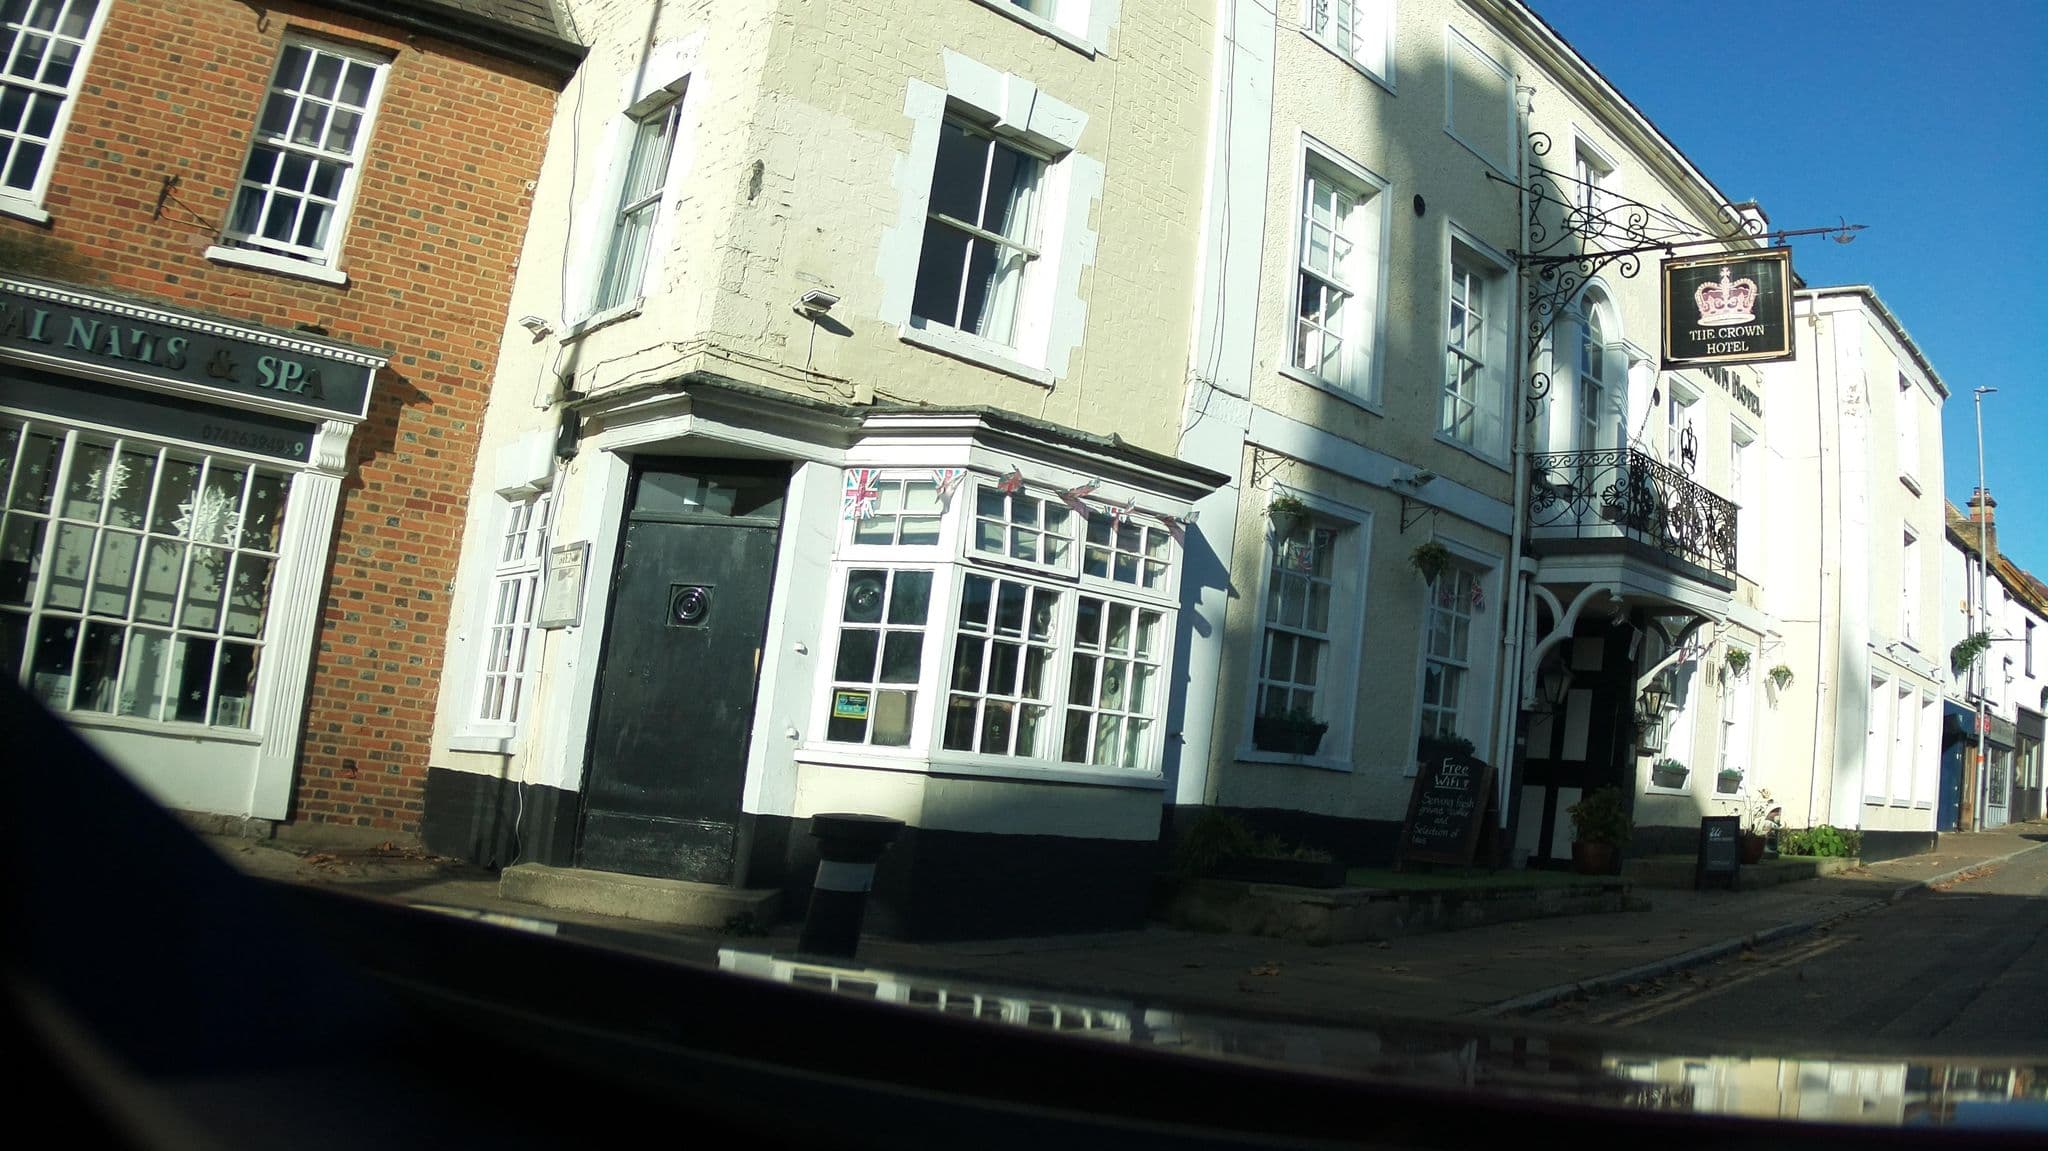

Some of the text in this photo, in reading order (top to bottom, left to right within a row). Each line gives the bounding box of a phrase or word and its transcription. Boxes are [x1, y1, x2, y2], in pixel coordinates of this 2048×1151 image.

[1689, 324, 1765, 341] THE CROWN
[1706, 341, 1749, 355] HOTEL
[63, 314, 190, 371] NAILS
[206, 349, 241, 384] &
[255, 354, 327, 400] SPA
[1699, 365, 1763, 418] OWN HOTEL
[1442, 757, 1470, 774] Free
